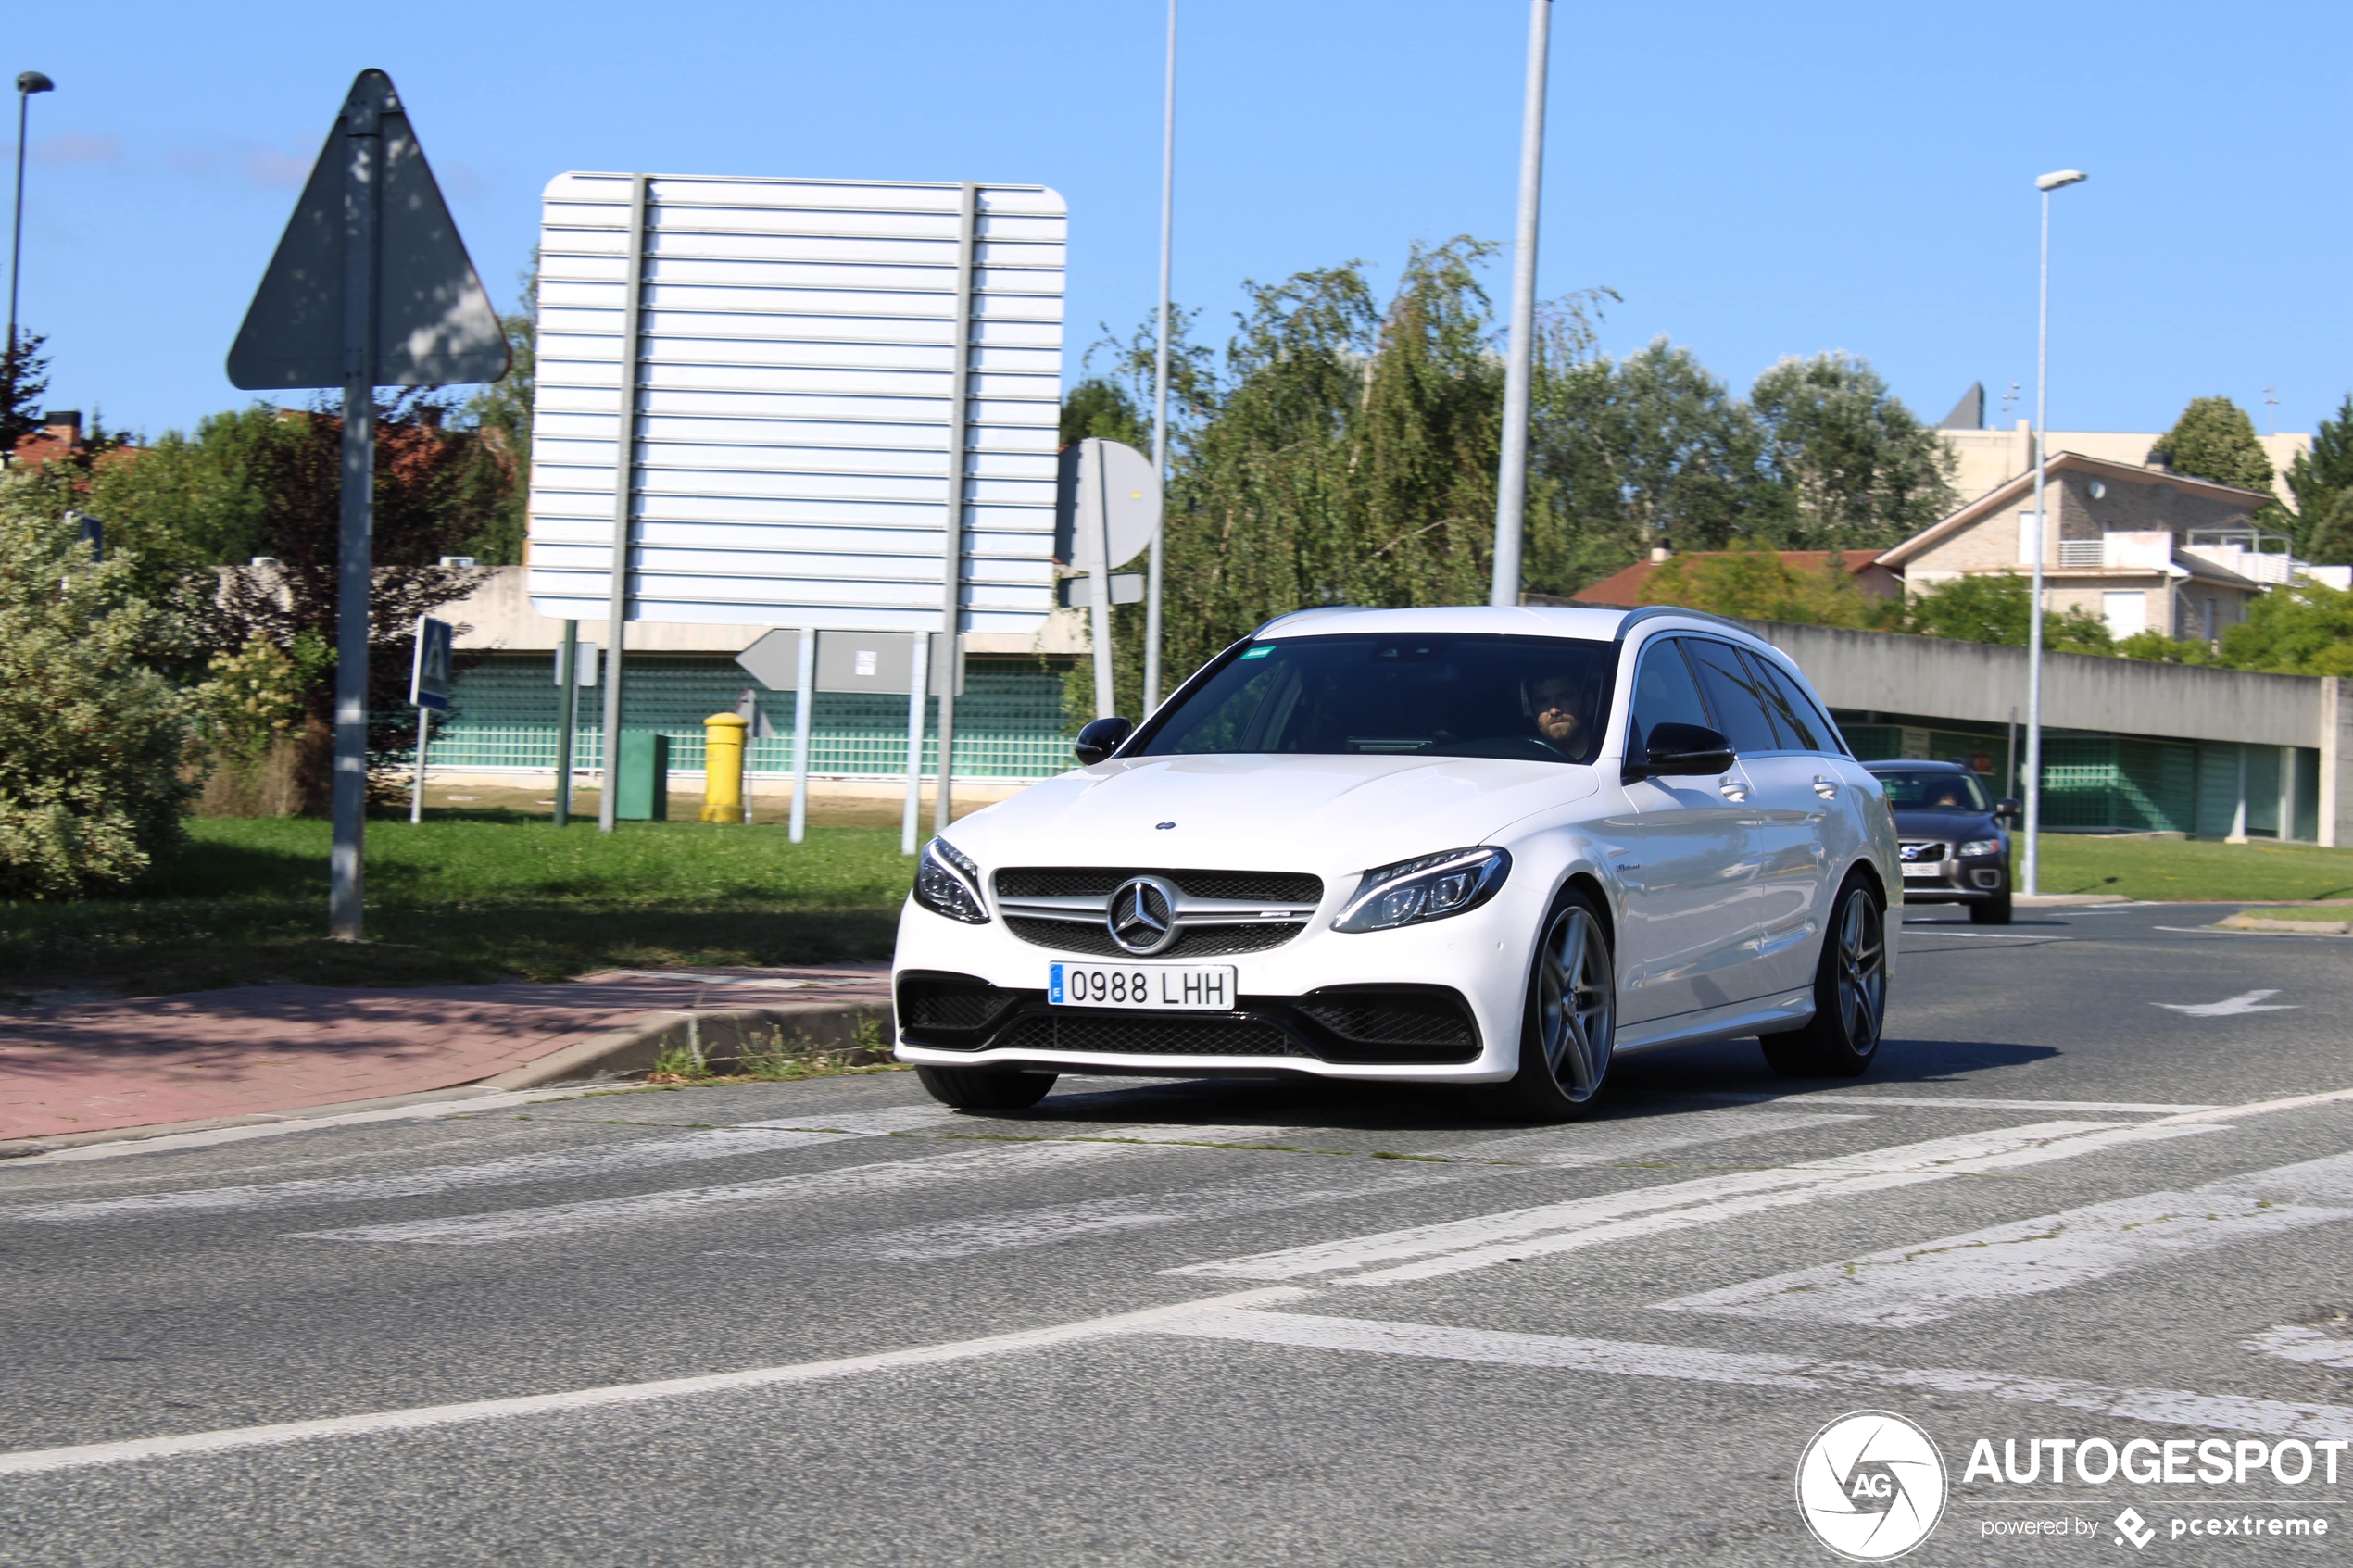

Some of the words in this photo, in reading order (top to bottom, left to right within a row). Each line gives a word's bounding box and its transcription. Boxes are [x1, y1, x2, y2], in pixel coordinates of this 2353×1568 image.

[1053, 987, 1062, 997] E
[1072, 971, 1148, 1003] 0988
[1162, 972, 1223, 1005] LHH
